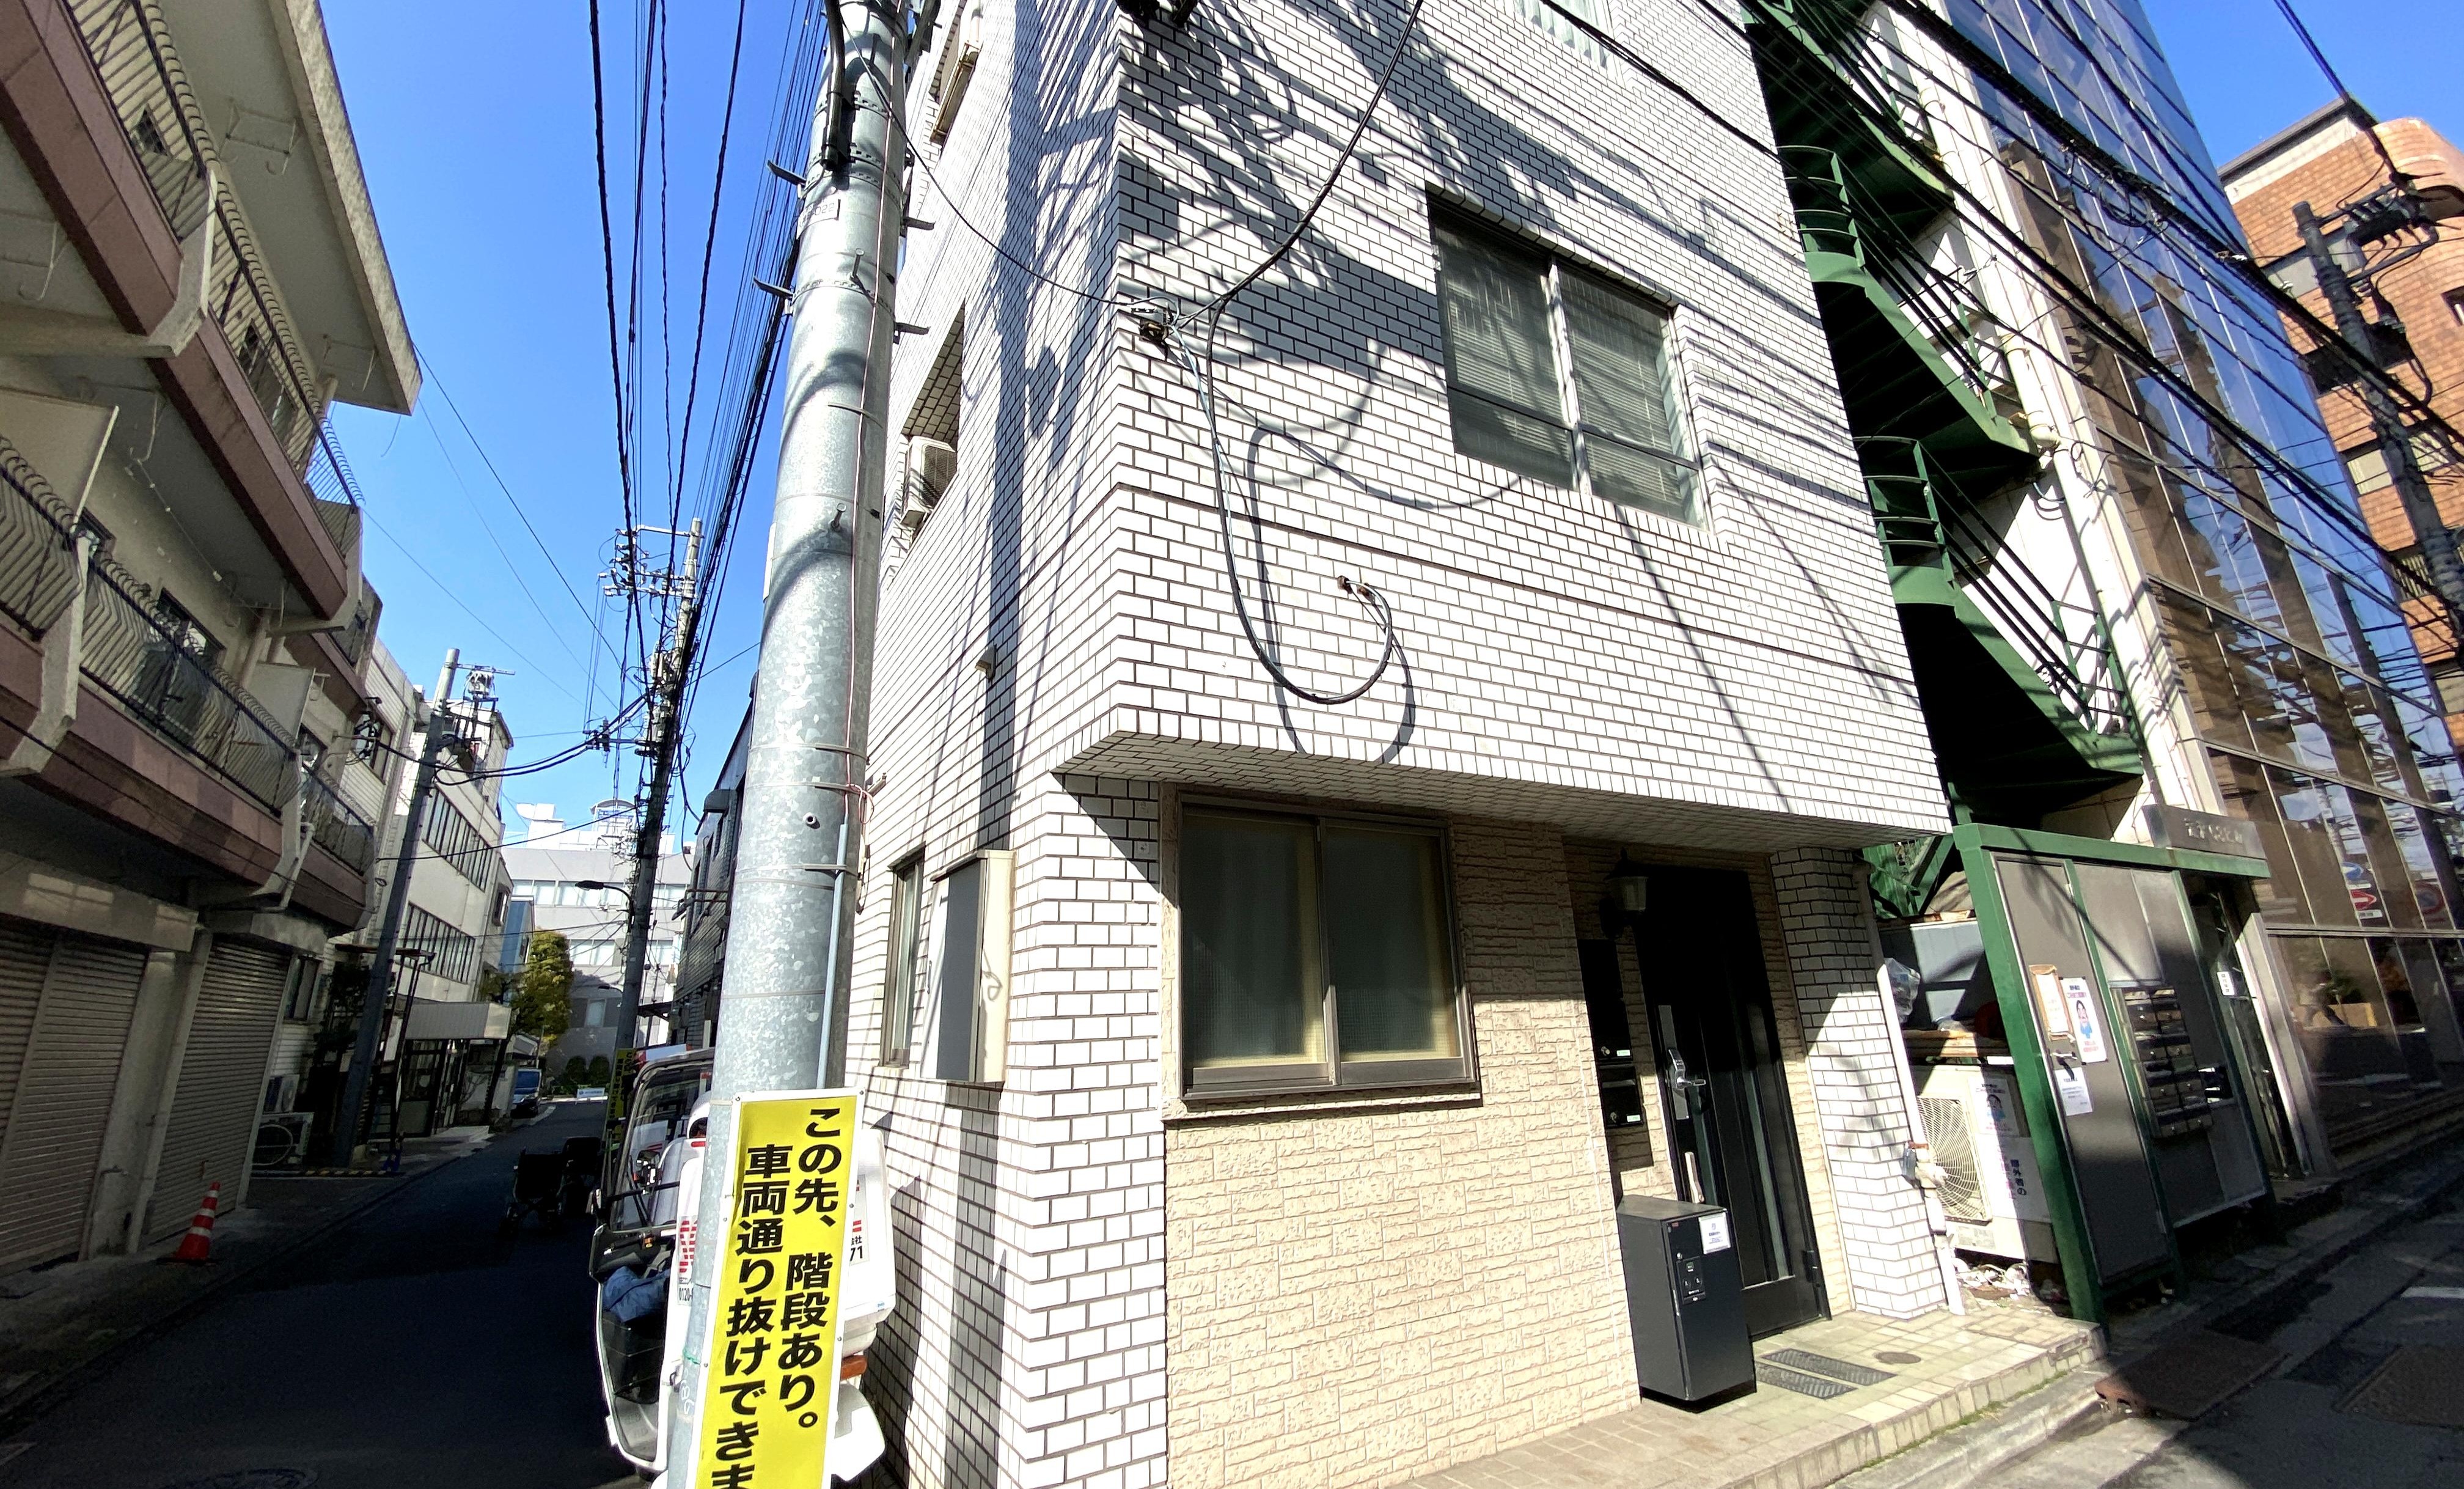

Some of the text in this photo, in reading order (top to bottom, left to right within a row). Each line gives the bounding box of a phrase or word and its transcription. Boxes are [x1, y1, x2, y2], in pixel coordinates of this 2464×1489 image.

[678, 1287, 694, 1301] 0120-
[711, 1144, 793, 1489] 車両通り抜けできま
[778, 1107, 842, 1428] この先、階段あり。
